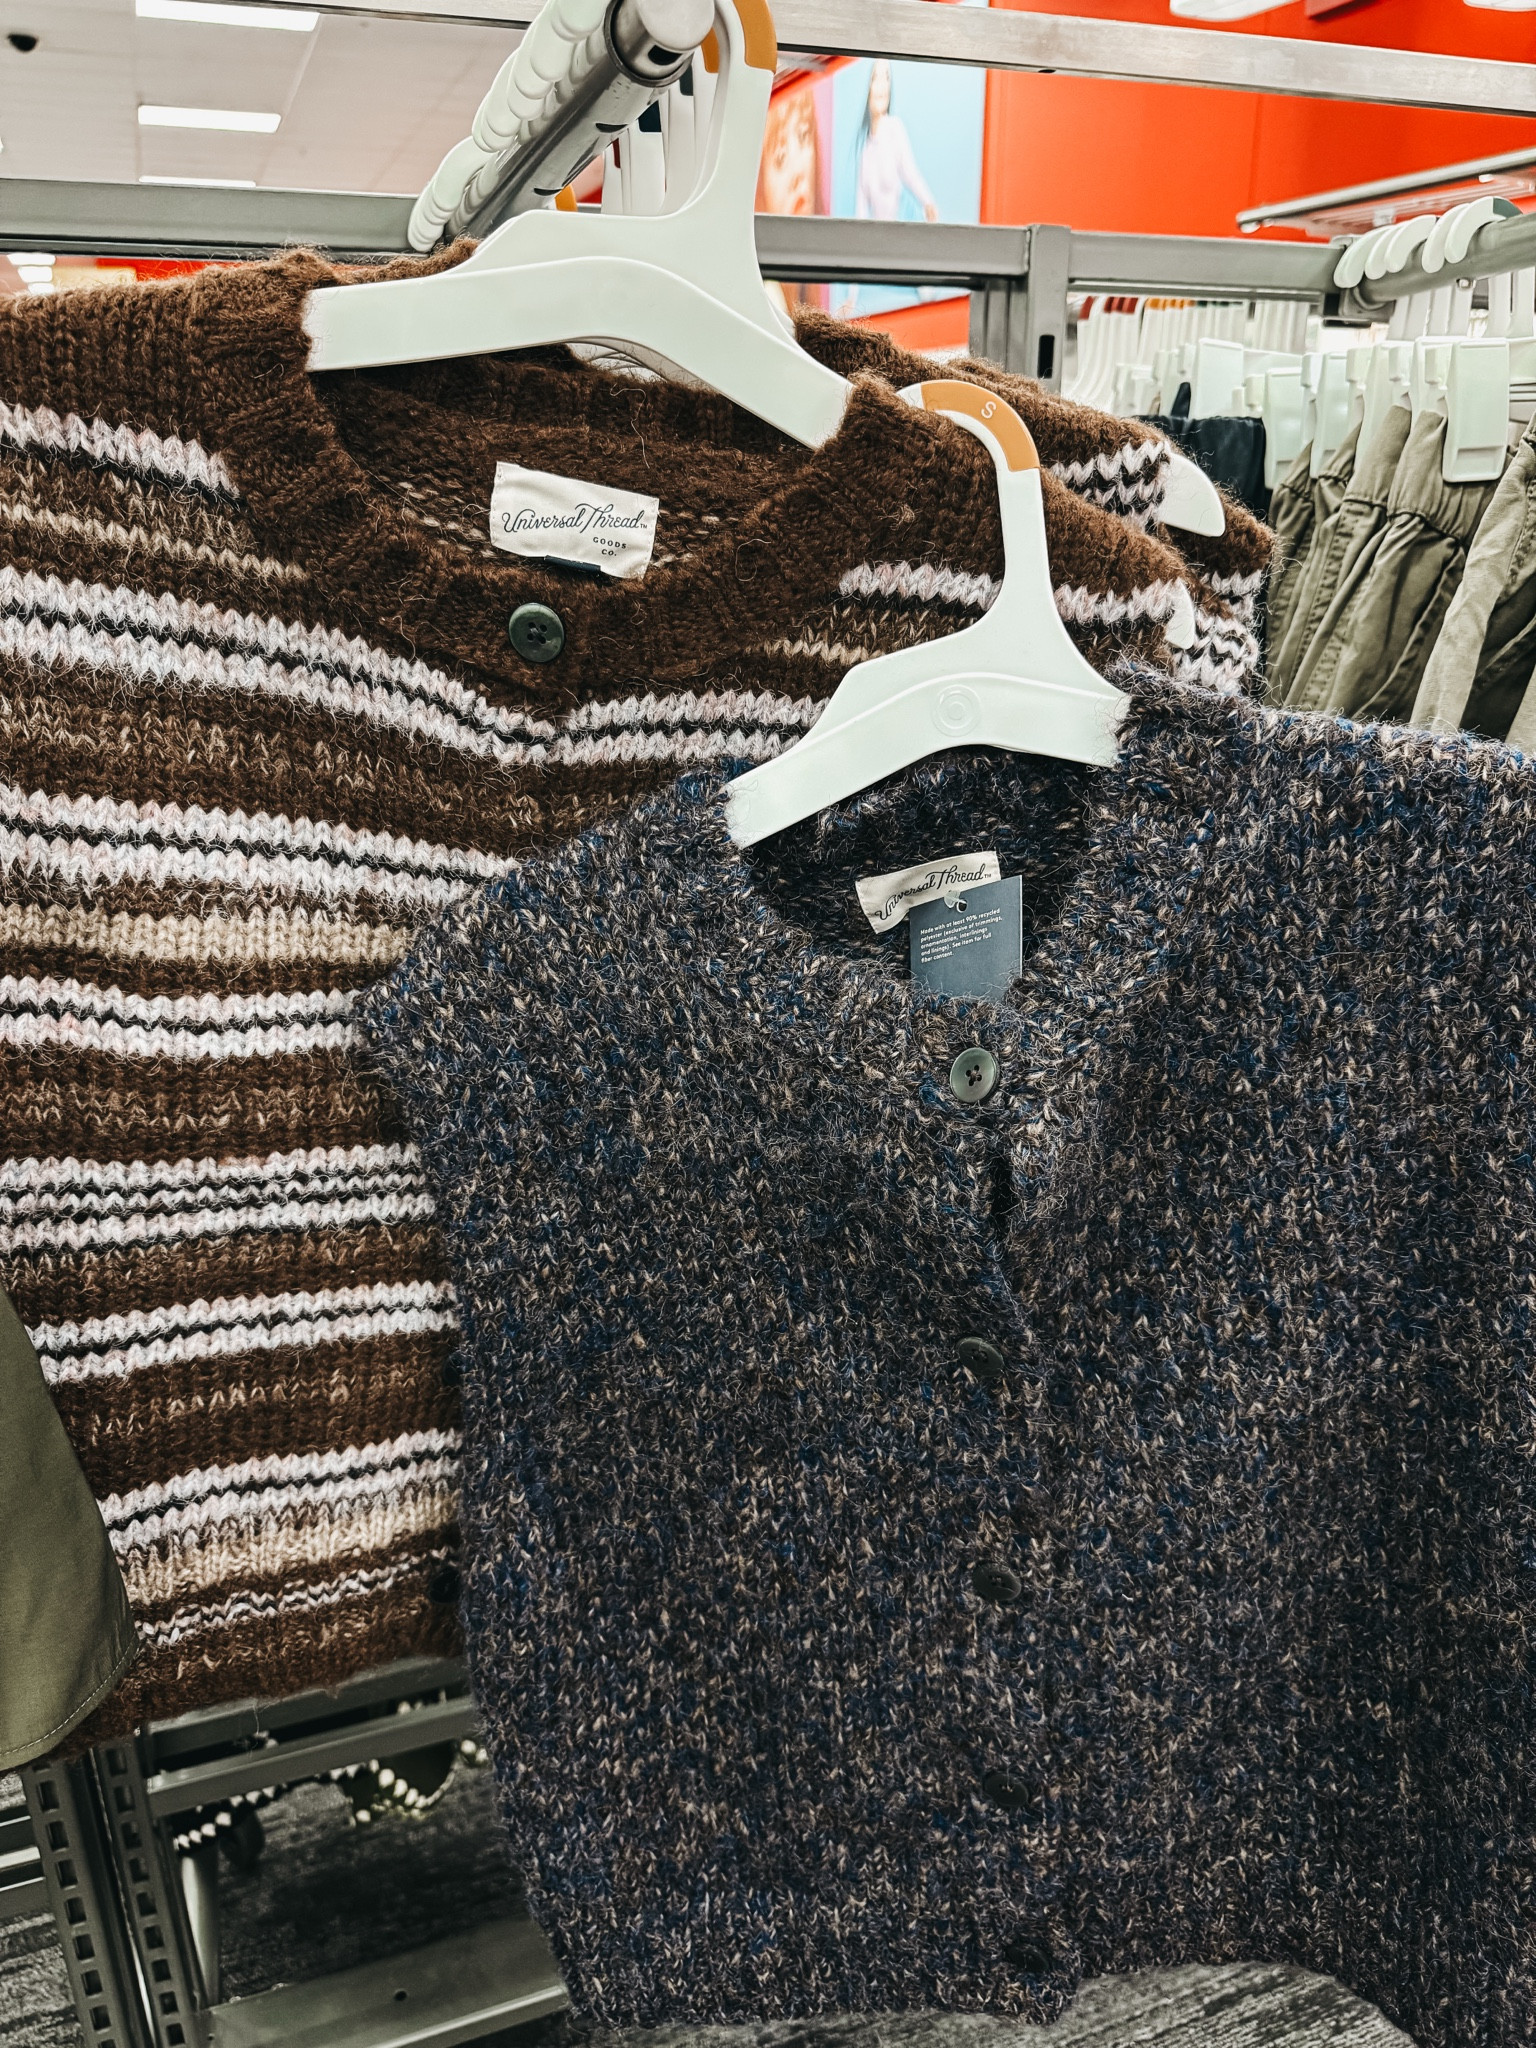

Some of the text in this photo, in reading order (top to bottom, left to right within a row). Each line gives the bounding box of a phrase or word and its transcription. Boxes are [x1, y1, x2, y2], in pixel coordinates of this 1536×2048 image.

[981, 401, 997, 419] S
[501, 508, 584, 533] Universal
[592, 536, 627, 550] GOODS
[601, 548, 617, 557] CO.
[874, 874, 937, 921] Universal
[920, 927, 934, 935] Made
[934, 923, 946, 931] with
[952, 918, 965, 926] least
[965, 914, 978, 922] 90%
[978, 907, 1001, 918] recycled
[920, 932, 943, 944] polyester
[920, 948, 931, 956] and
[982, 932, 992, 940] full
[920, 956, 933, 964] fiber
